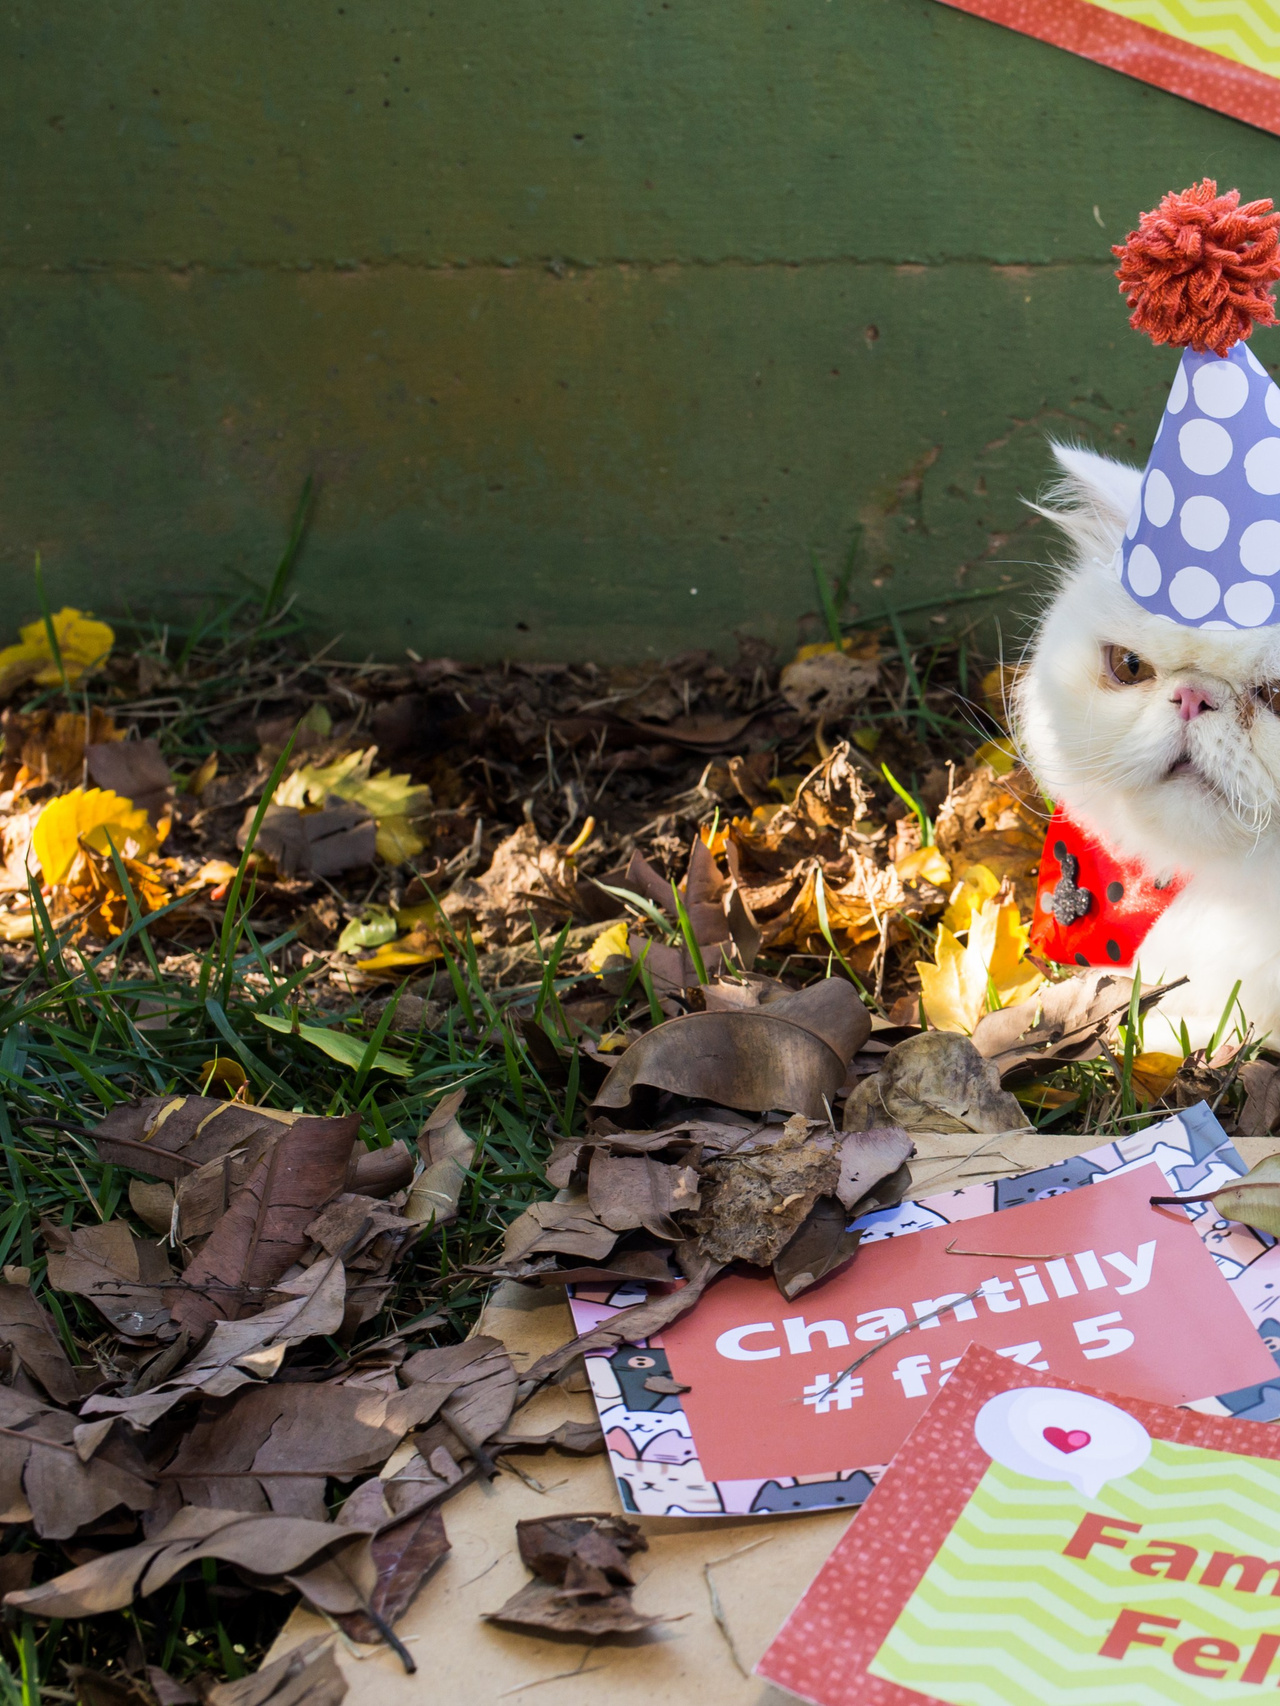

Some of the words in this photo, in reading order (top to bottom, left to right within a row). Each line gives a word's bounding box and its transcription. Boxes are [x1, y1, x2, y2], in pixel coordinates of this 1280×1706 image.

[715, 1239, 1157, 1362] Chantilly
[803, 1371, 864, 1414] #
[1072, 1310, 1135, 1361] 5
